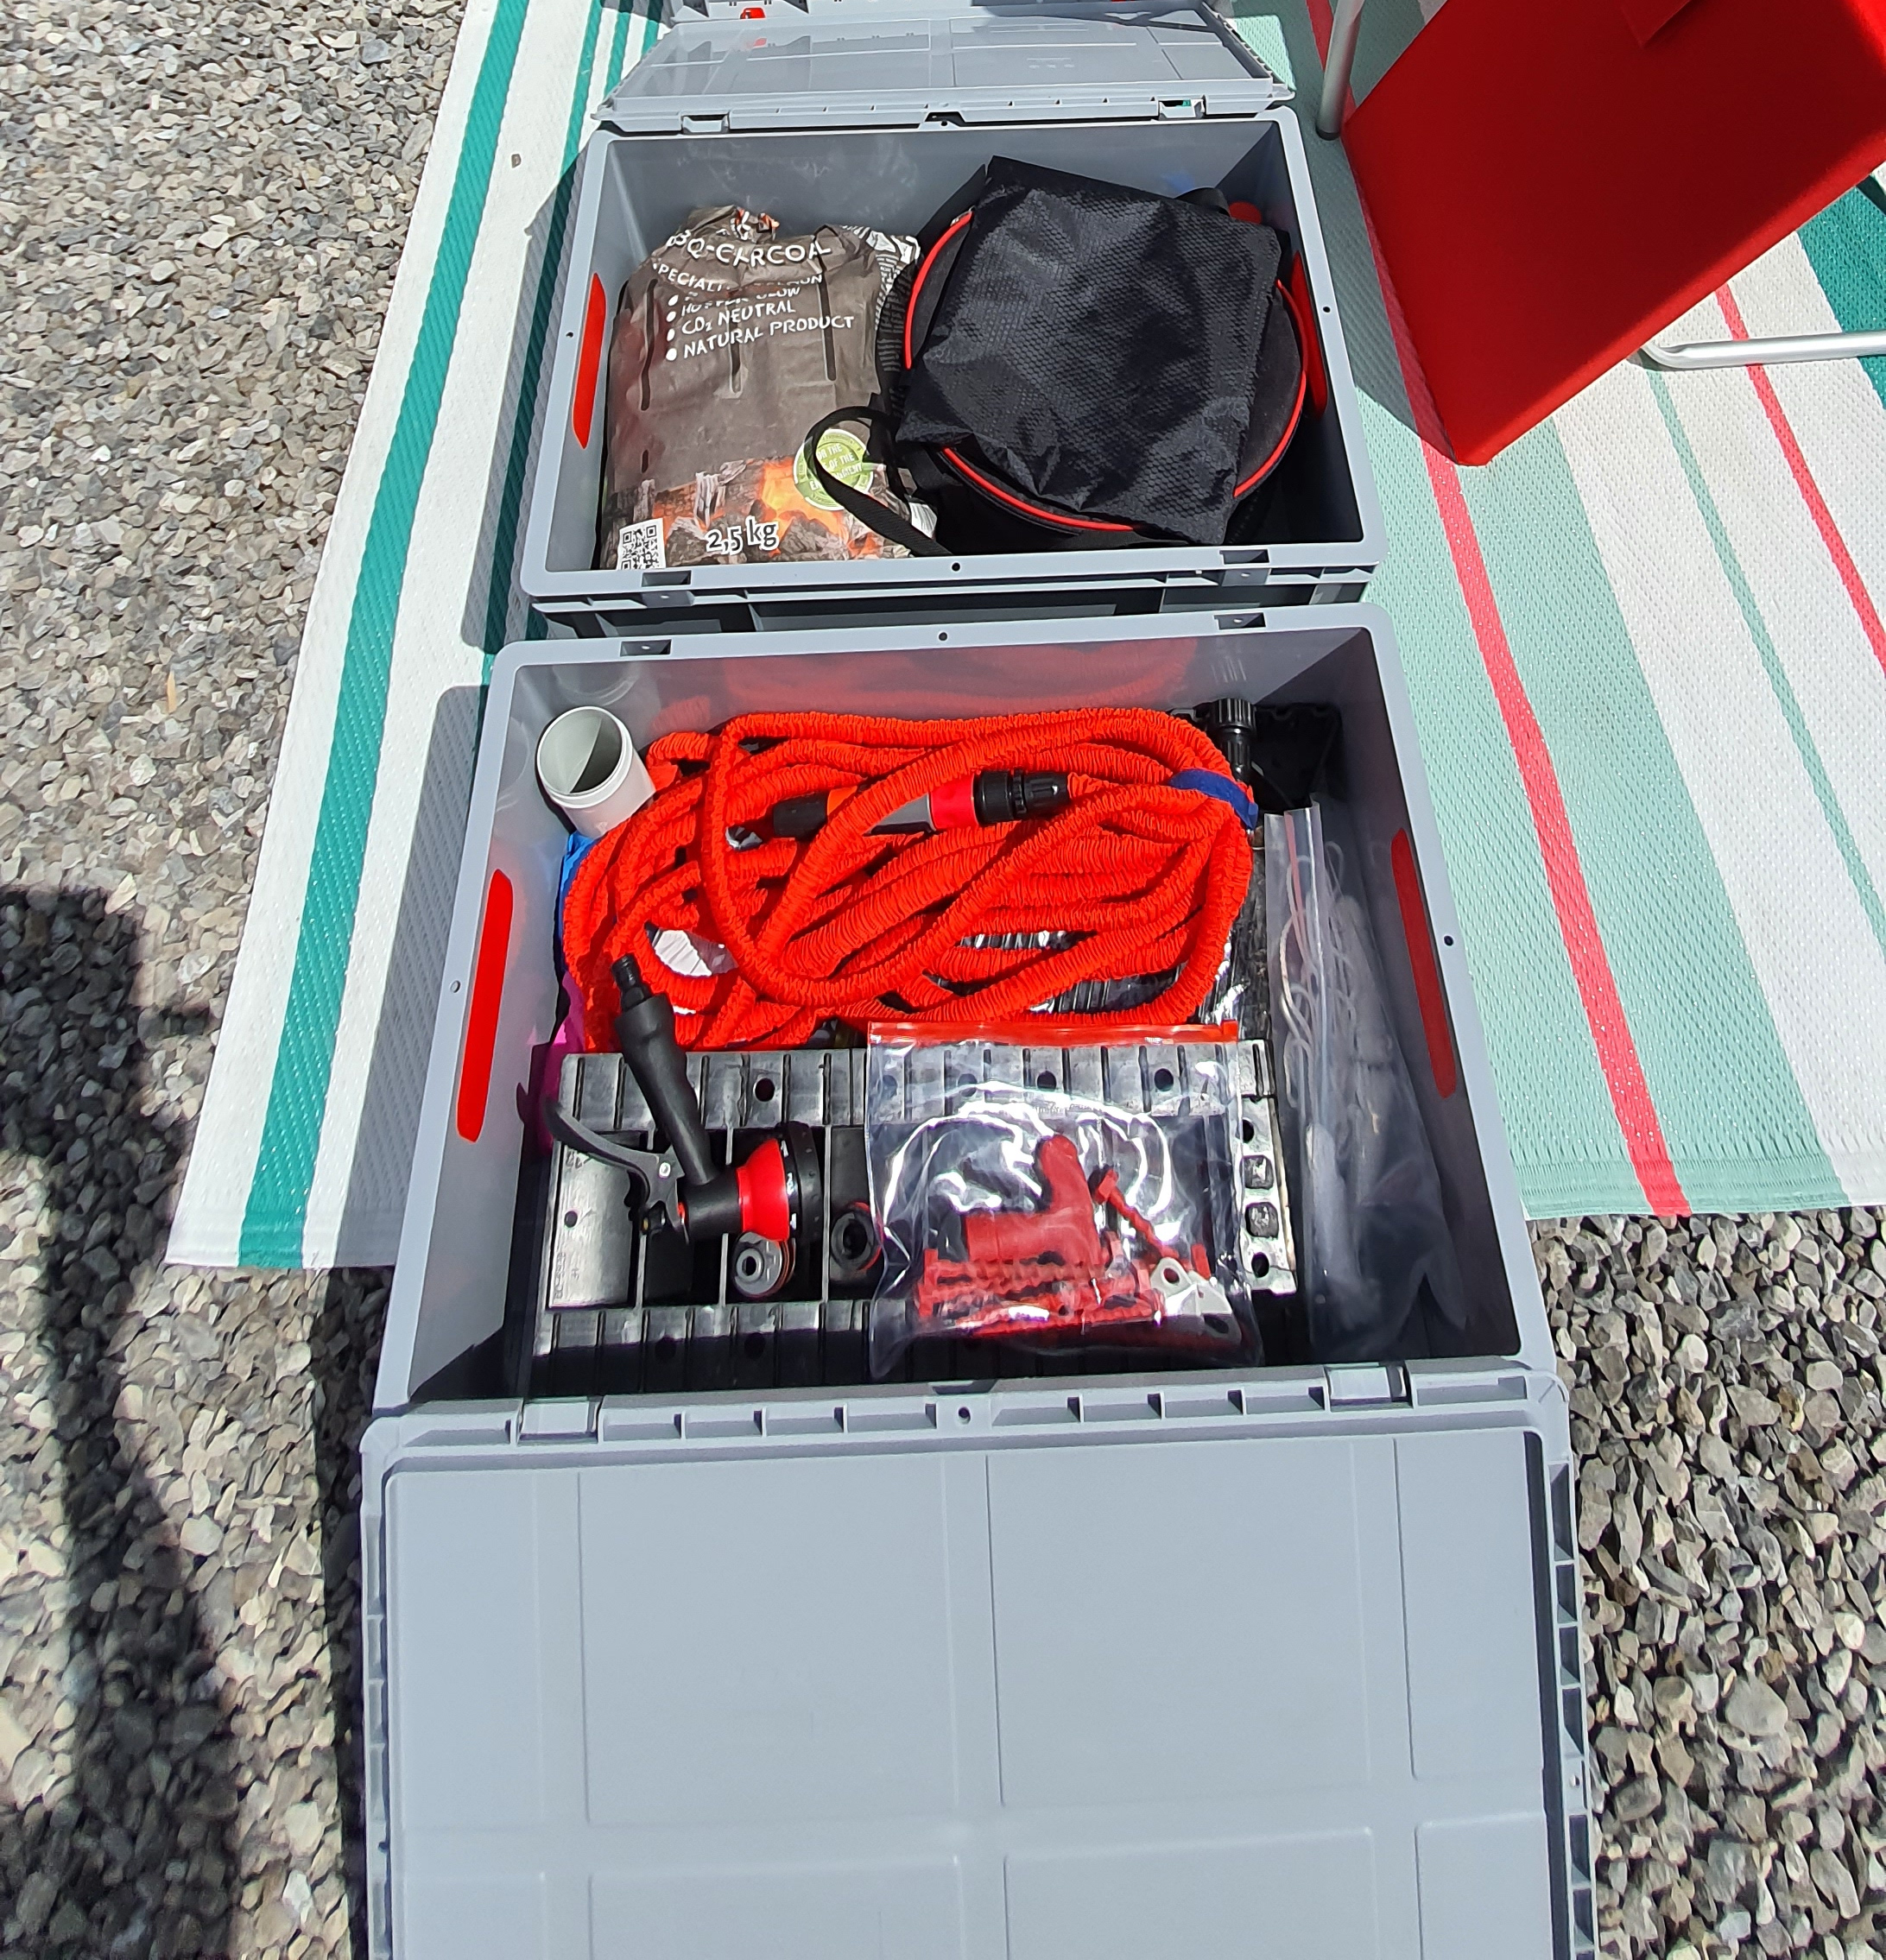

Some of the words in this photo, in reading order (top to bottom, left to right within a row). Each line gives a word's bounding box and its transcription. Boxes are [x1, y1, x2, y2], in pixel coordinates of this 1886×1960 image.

[718, 300, 796, 326] NEUTRAL
[683, 326, 764, 359] NATURAL
[769, 315, 855, 336] PRODUCT
[706, 527, 743, 555] 2,5
[746, 516, 779, 550] kg
